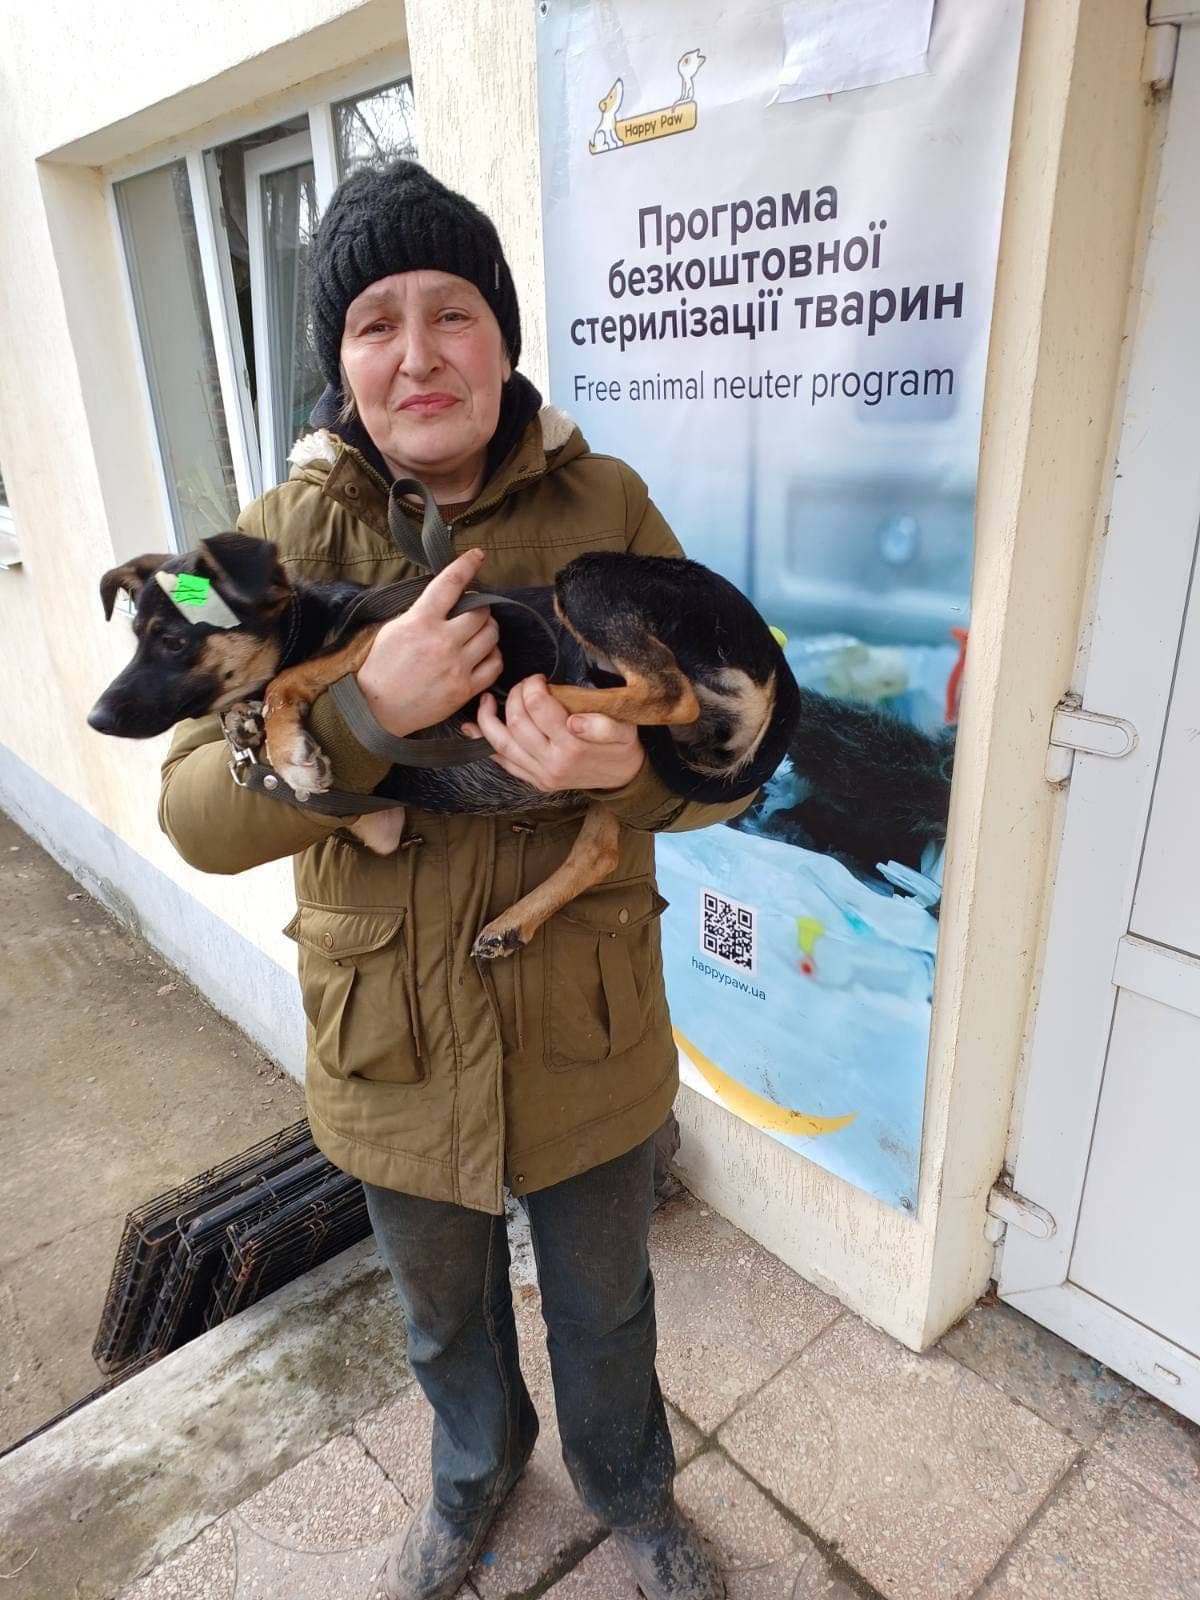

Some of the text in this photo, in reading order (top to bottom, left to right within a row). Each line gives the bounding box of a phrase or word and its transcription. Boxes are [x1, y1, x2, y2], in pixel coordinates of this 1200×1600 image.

[624, 112, 683, 138] Happy Paw
[637, 184, 839, 255] Програма
[608, 220, 887, 299] безкоштовної
[570, 282, 964, 352] стерилізації тварин
[573, 368, 955, 406] Free animal neuter program
[691, 956, 766, 1000] happypaw.ua
